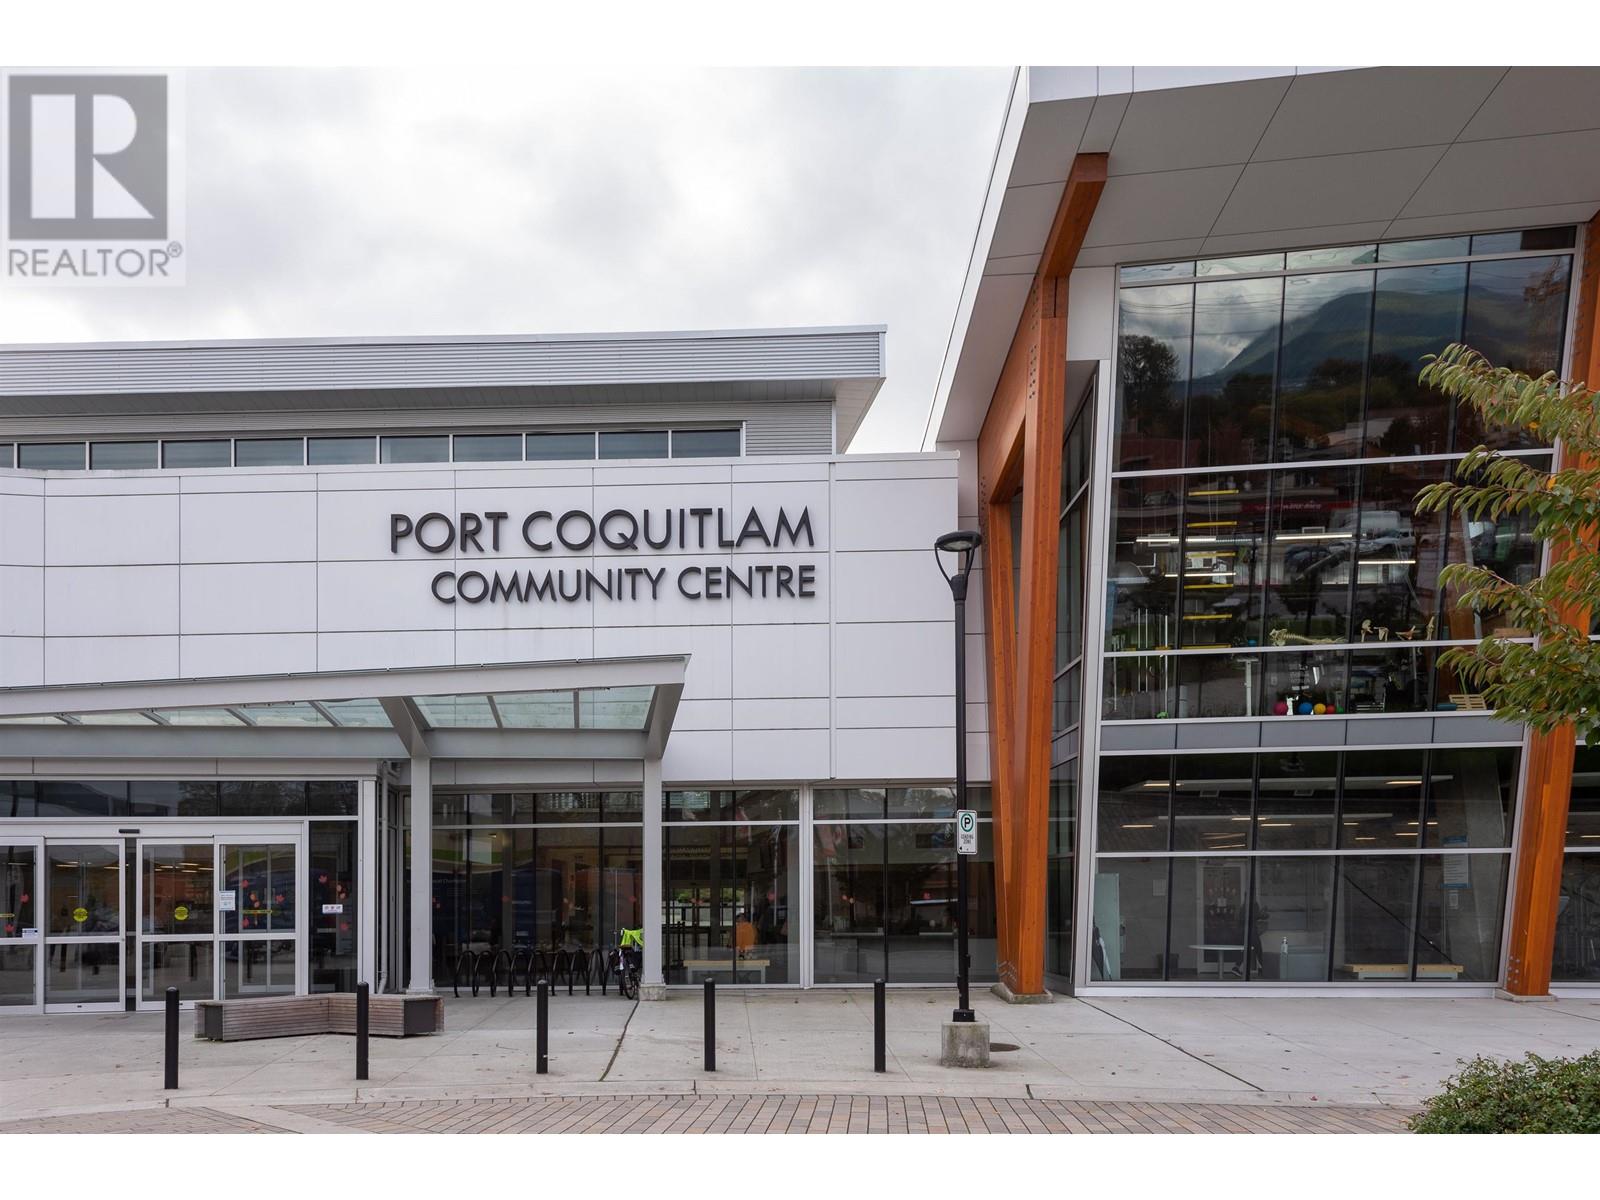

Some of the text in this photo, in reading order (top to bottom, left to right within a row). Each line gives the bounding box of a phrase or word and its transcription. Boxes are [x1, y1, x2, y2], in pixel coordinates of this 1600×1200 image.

[390, 505, 814, 553] PORT COQUITLAM
[431, 564, 816, 604] COMMUNITY CENTRE
[964, 817, 971, 828] P
